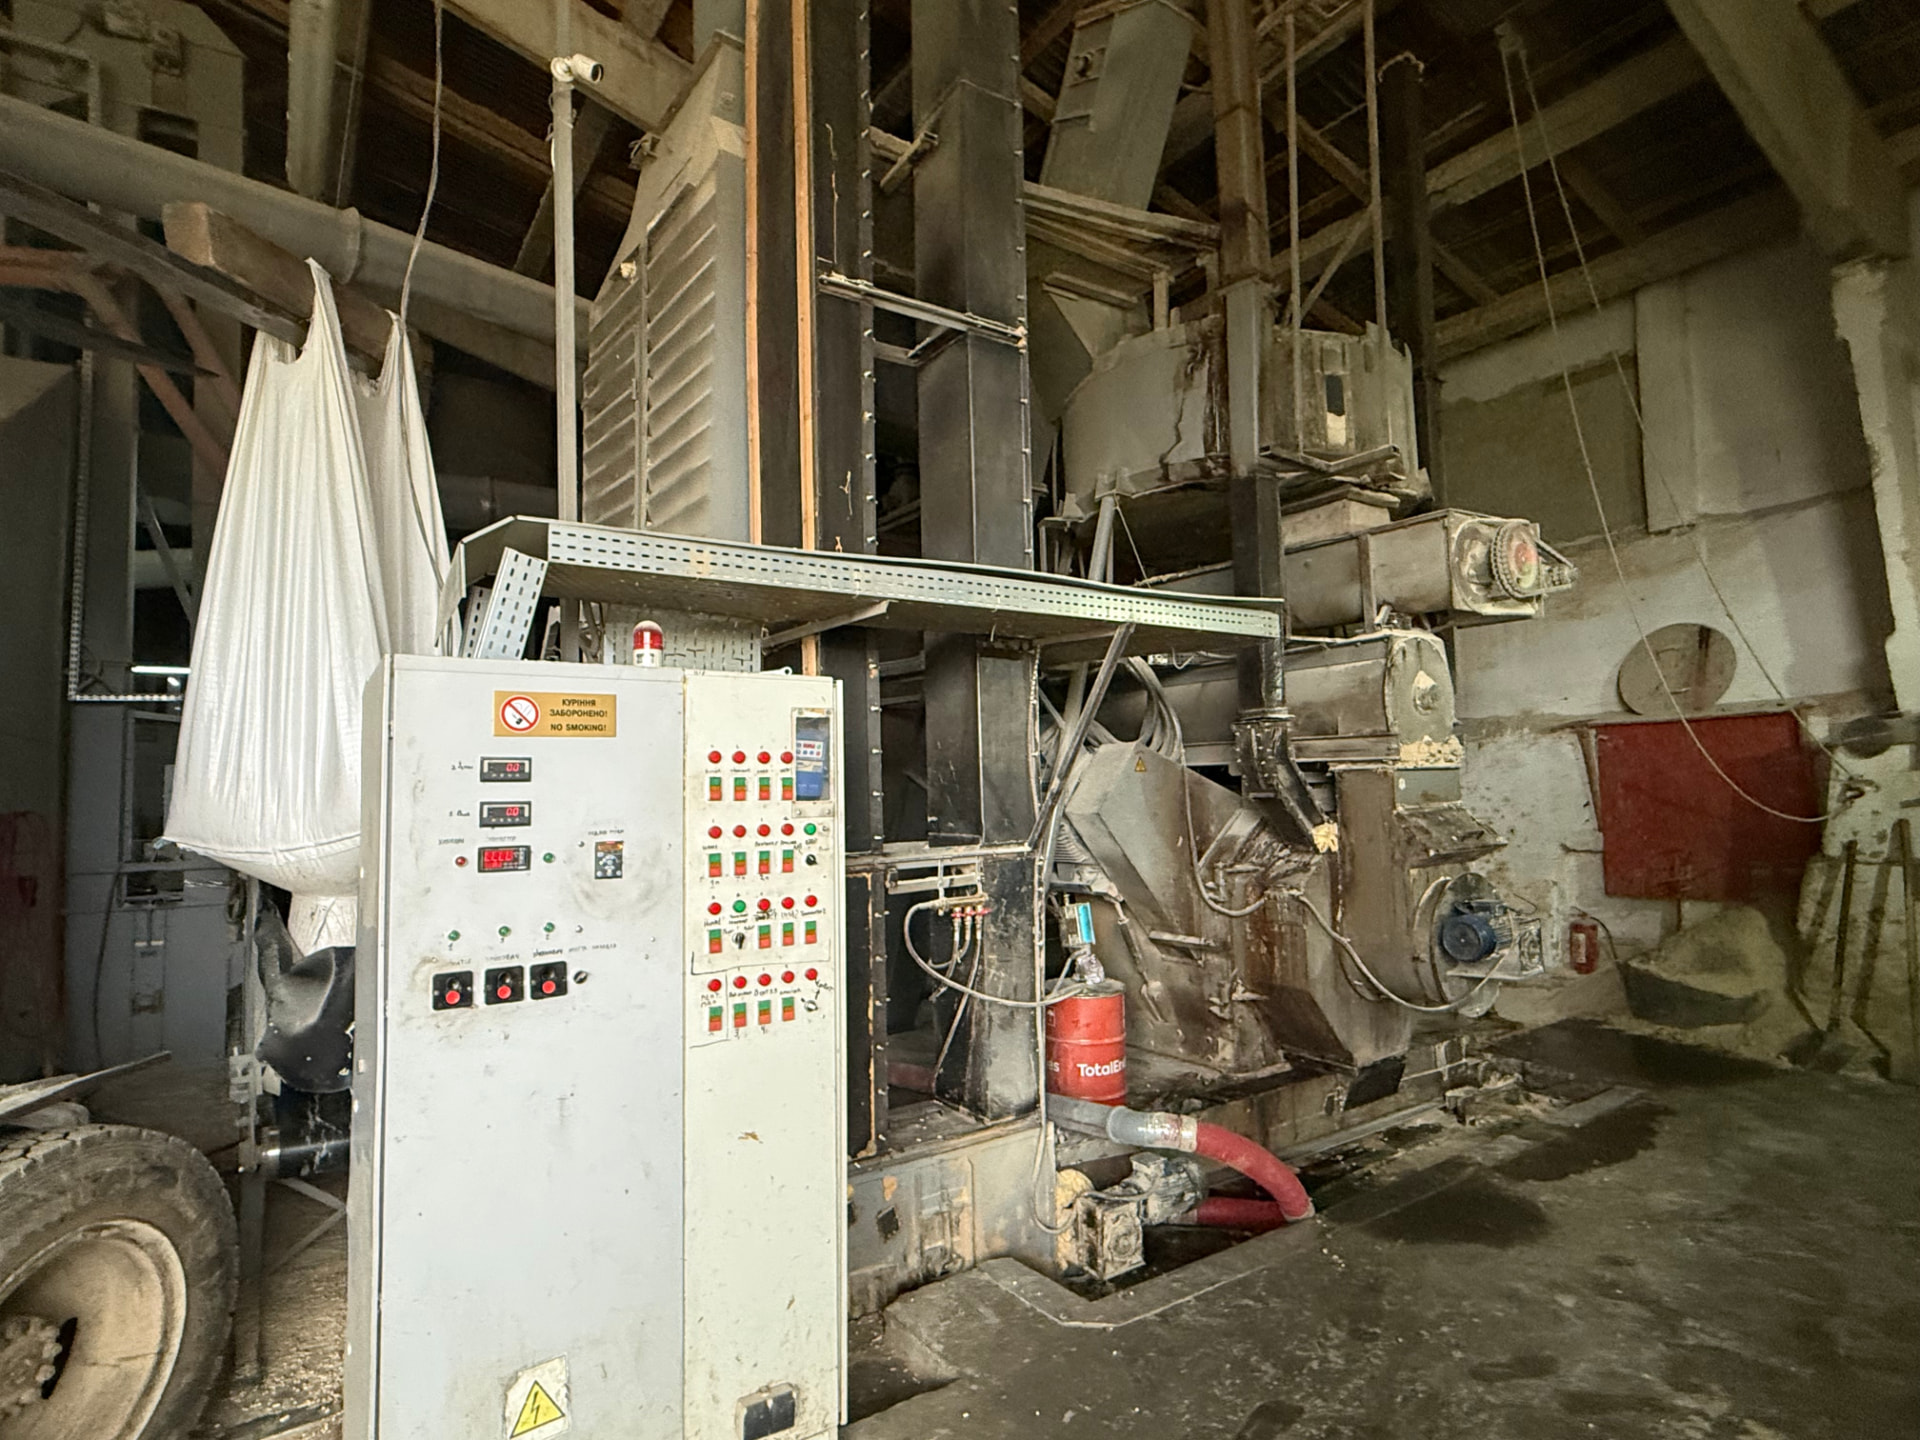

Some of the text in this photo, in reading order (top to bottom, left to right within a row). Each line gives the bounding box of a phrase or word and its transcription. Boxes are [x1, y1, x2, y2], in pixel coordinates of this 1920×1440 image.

[549, 709, 608, 717] ЗАБОРОНЕНО!
[550, 723, 607, 732] NO SMOKING!
